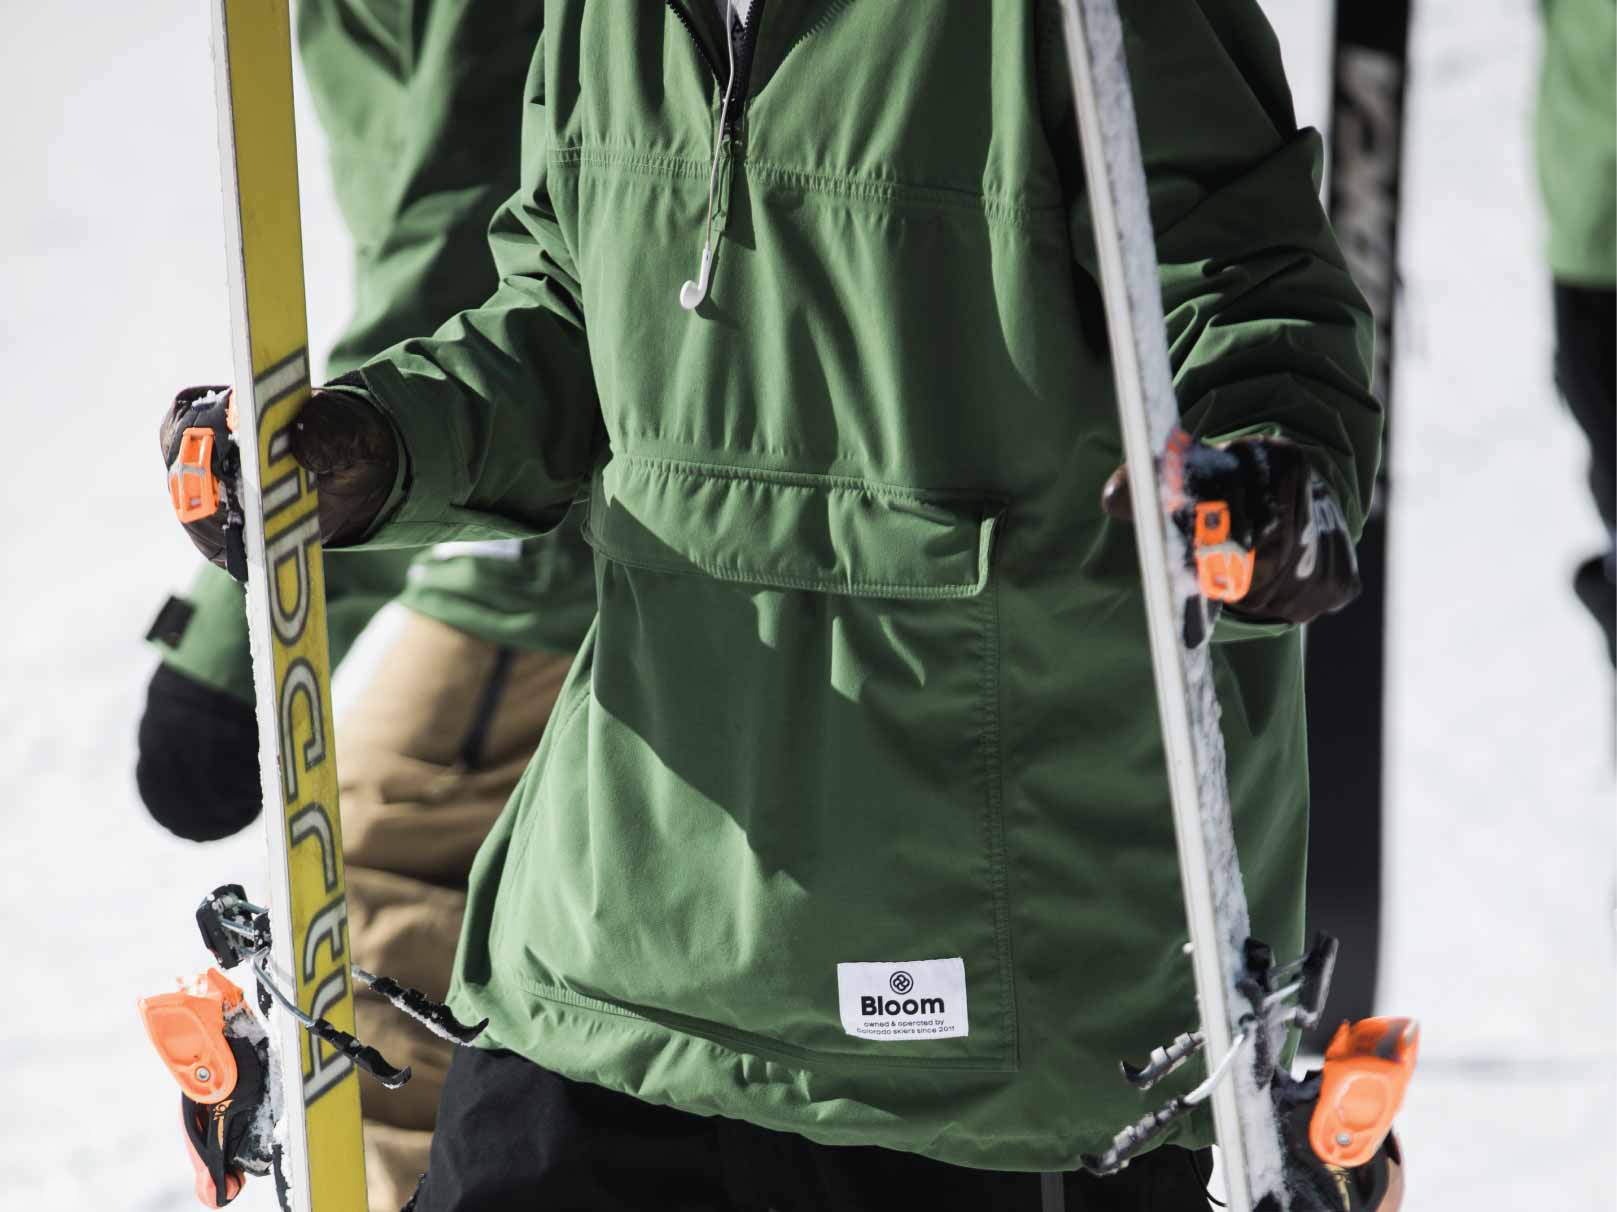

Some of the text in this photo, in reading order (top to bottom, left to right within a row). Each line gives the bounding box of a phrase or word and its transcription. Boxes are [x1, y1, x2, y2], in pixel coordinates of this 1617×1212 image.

[861, 995, 945, 1016] Bloom
[864, 1020, 890, 1028] owned
[897, 1020, 933, 1028] operated
[893, 1026, 915, 1034] skiers
